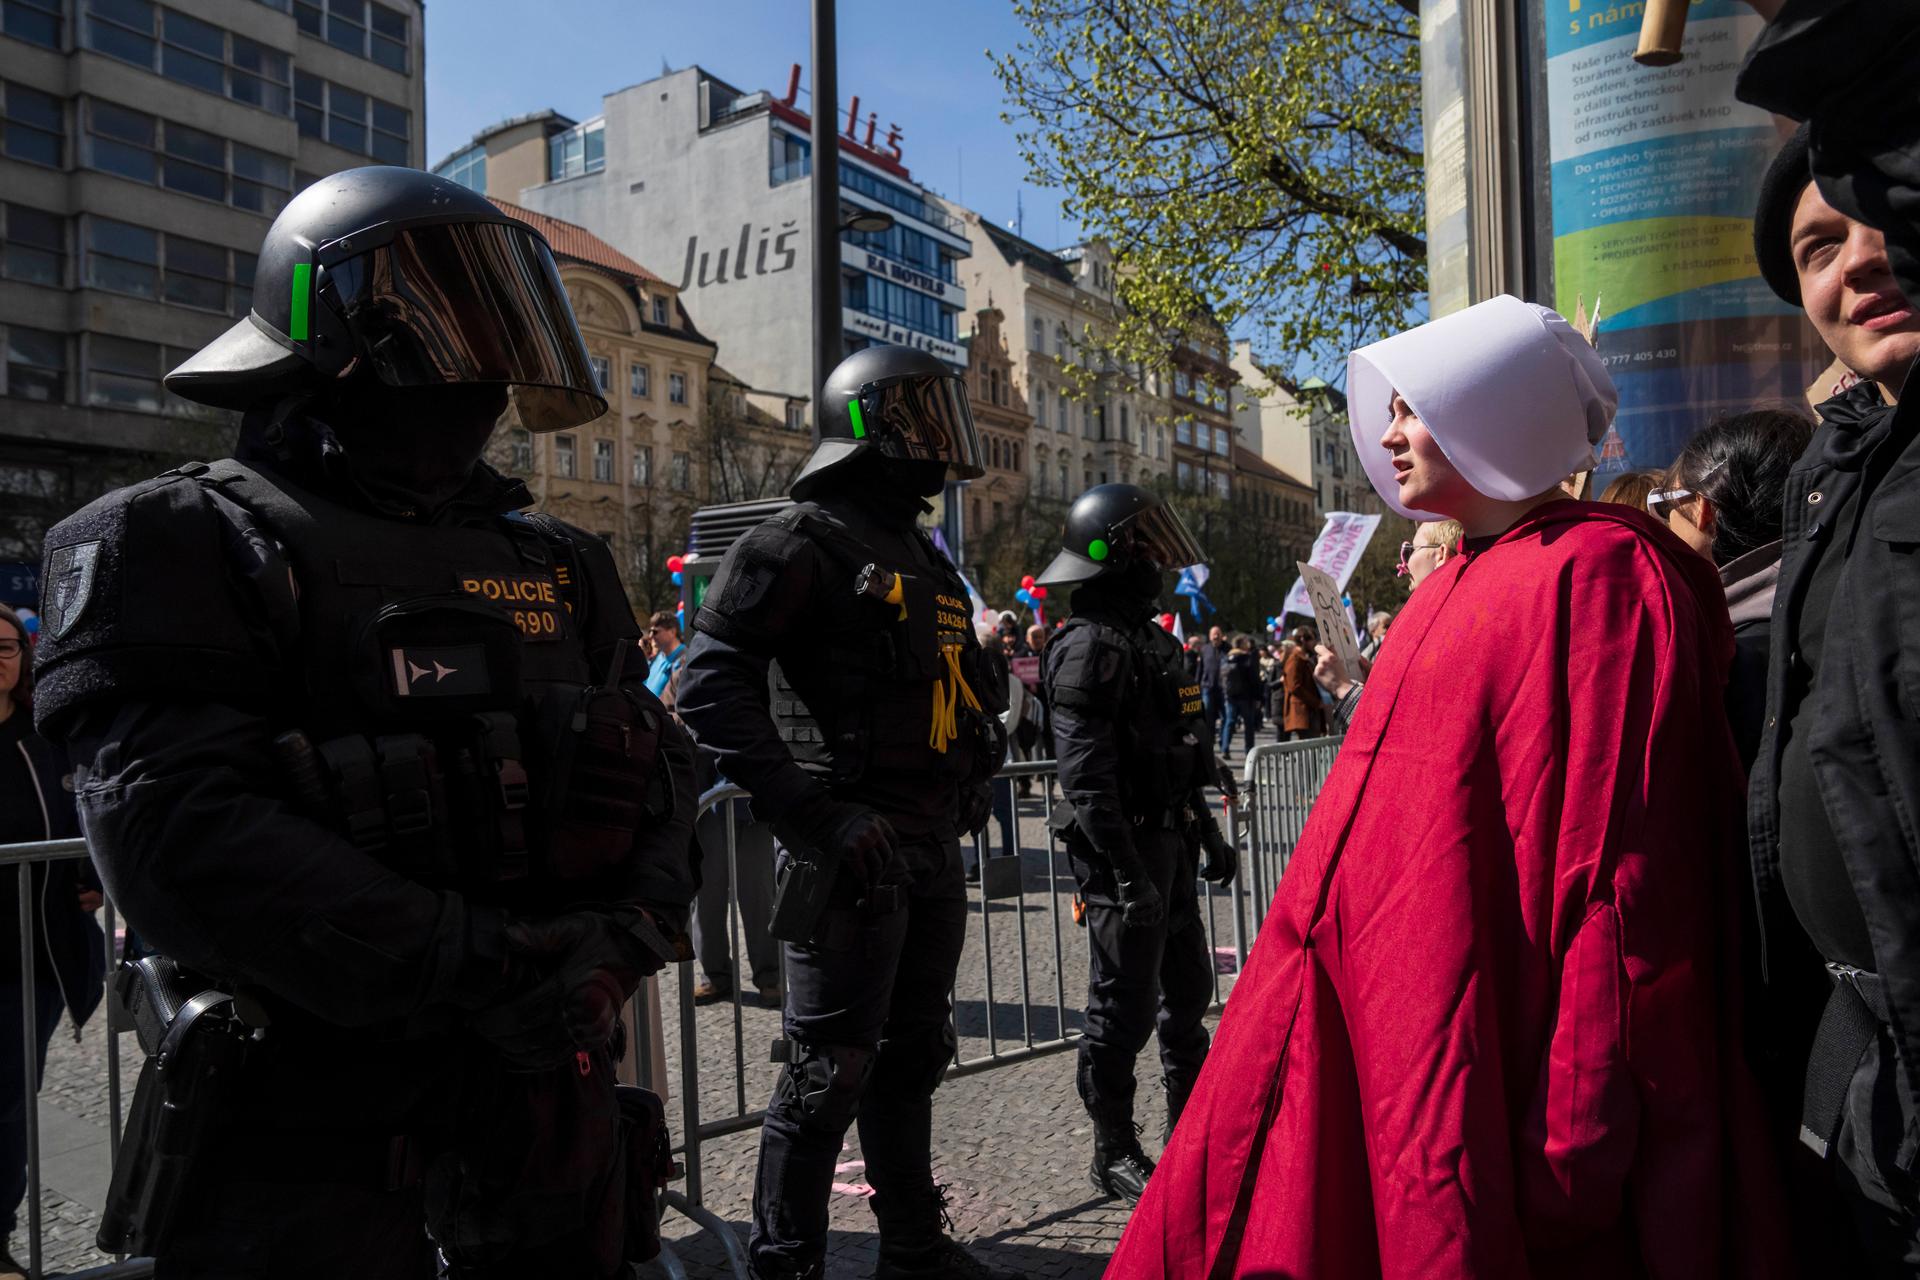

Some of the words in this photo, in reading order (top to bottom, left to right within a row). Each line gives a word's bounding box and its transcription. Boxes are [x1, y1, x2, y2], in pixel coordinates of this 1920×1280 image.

[1569, 19, 1581, 35] s
[1588, 2, 1643, 29] nám
[1572, 56, 1601, 73] Naše
[1572, 67, 1623, 88] Staráme
[1626, 61, 1639, 71] se
[1573, 79, 1631, 102] osvětlení,
[1634, 66, 1696, 85] semafory,
[1574, 108, 1581, 116] a
[1584, 96, 1612, 113] další
[1615, 82, 1686, 105] technickou
[782, 63, 904, 163] Jliš
[1574, 102, 1660, 131] infrastrukturu
[1575, 130, 1590, 145] od
[1594, 117, 1638, 140] nových
[1641, 107, 1696, 129] zastávek
[1699, 105, 1731, 120] MHD
[1575, 163, 1592, 176] Do
[1595, 152, 1640, 170] našeho
[679, 219, 800, 292] Juliš
[867, 254, 888, 276] EA
[891, 264, 945, 297] HOTELS
[1611, 353, 1632, 366] 777
[1633, 351, 1654, 362] 405
[1656, 348, 1678, 360] 430
[463, 579, 557, 604] POLICIE
[513, 610, 556, 635] 690
